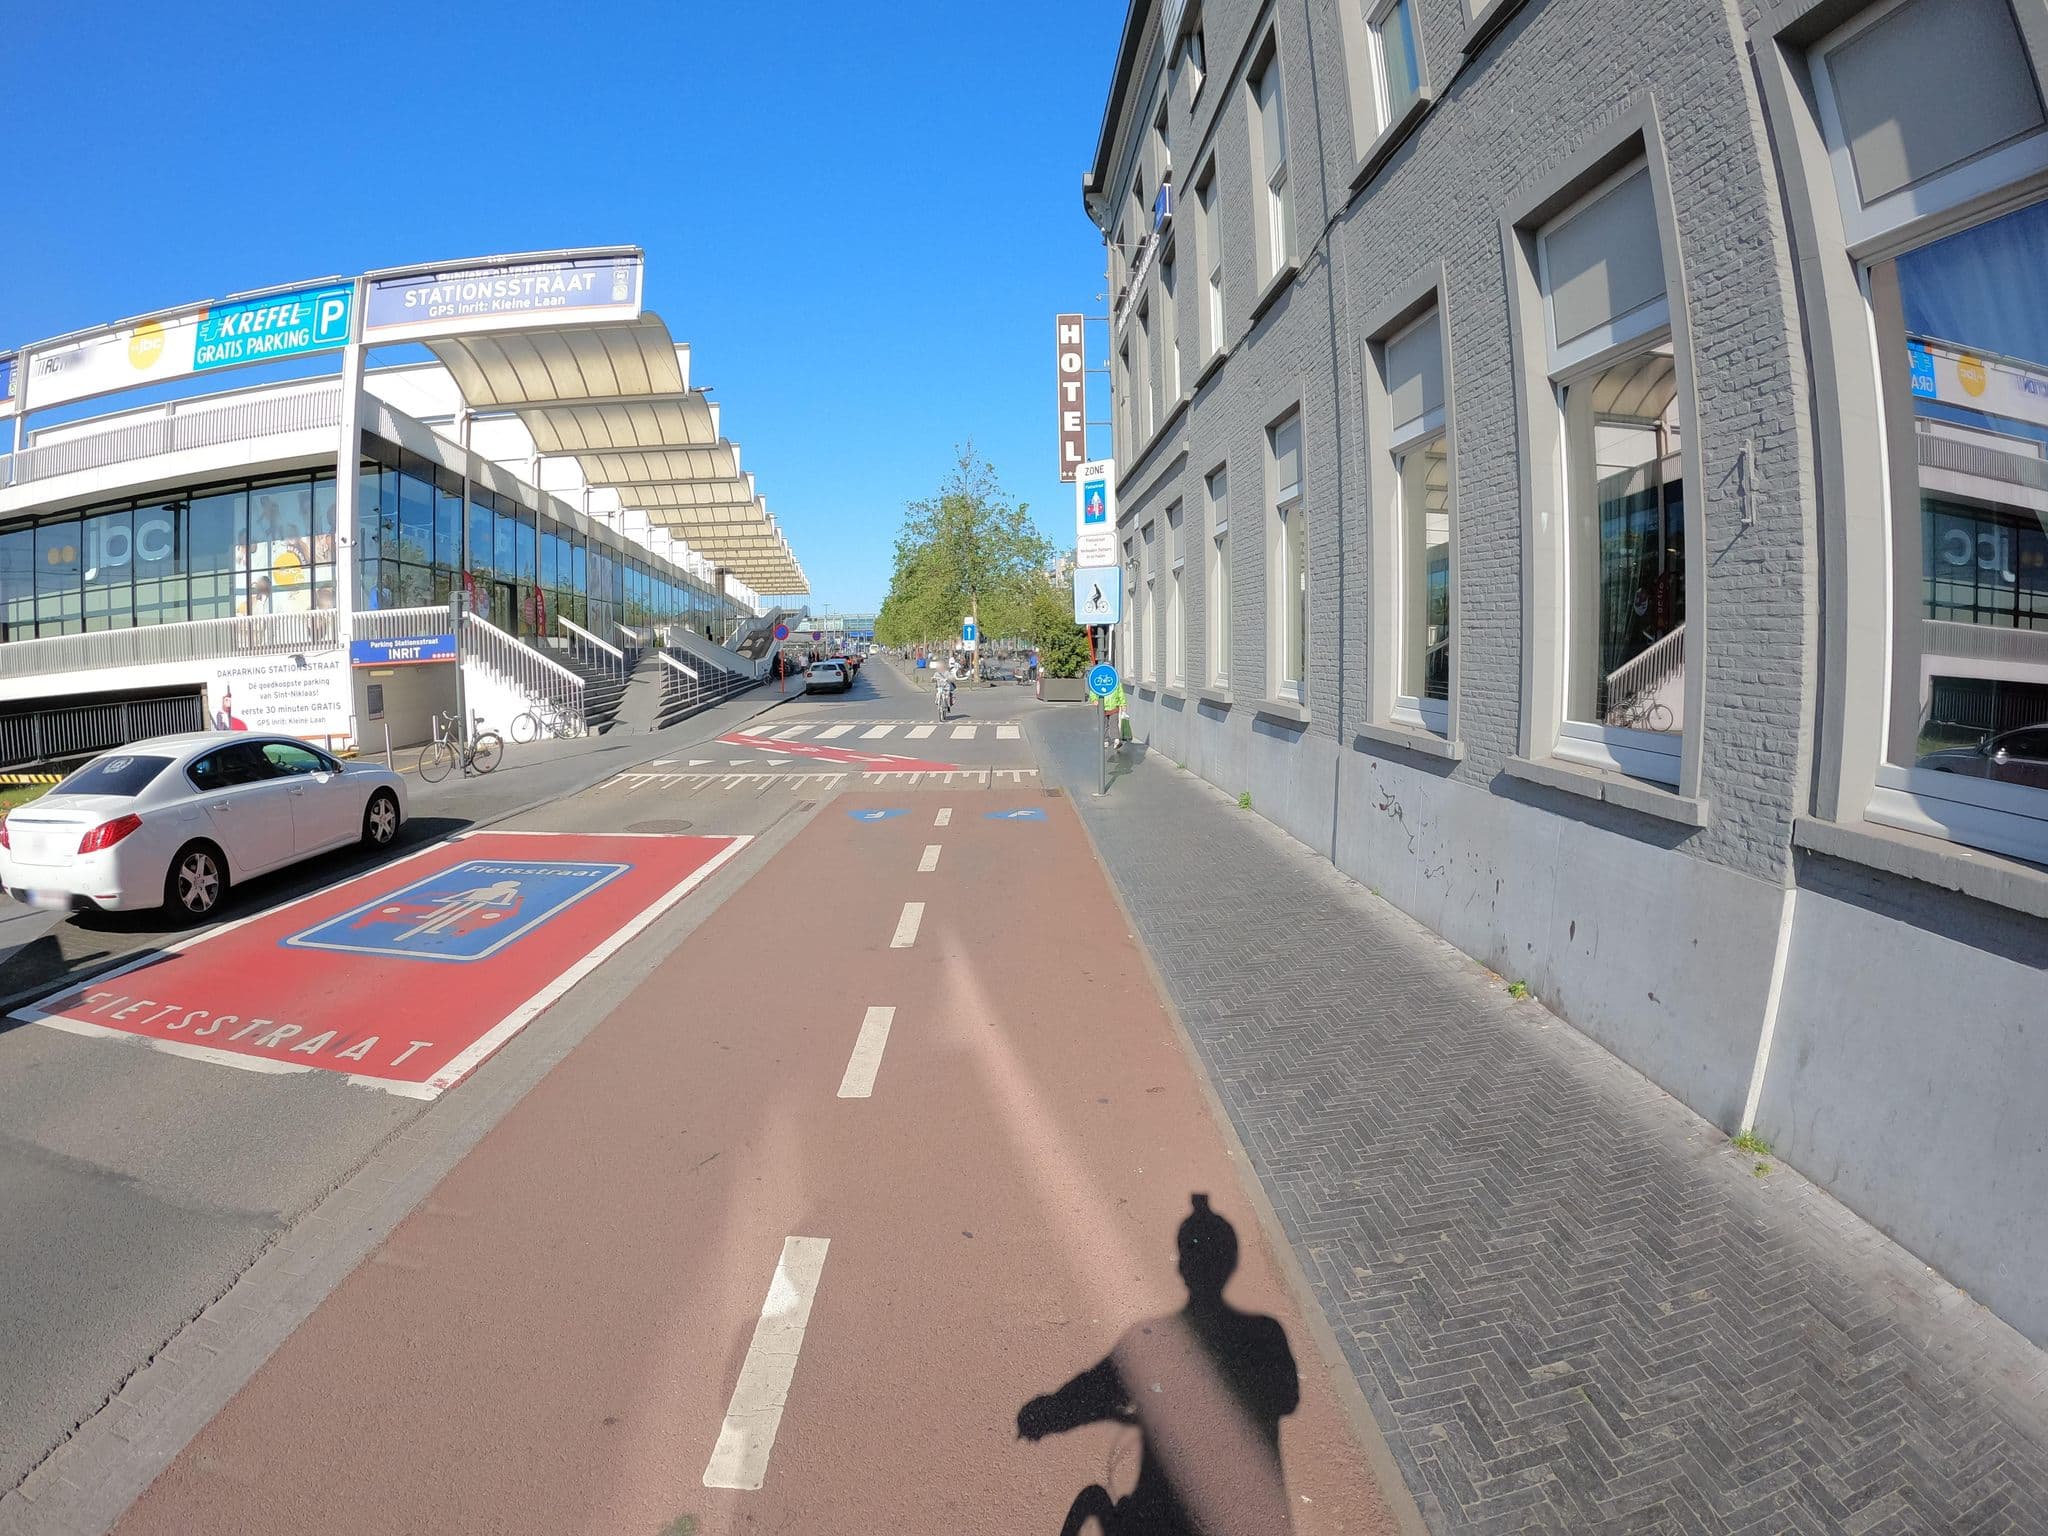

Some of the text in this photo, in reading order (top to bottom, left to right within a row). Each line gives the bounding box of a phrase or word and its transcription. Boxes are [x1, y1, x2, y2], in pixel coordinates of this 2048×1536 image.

[404, 272, 596, 308] STATIONSSTRAAT
[429, 304, 454, 317] GPS
[491, 297, 530, 310] Kleine
[534, 295, 566, 307] Laan
[320, 299, 345, 335] P
[197, 328, 309, 363] GRATIS PARKING
[1060, 324, 1082, 462] HOTEL
[1084, 464, 1105, 476] ZONE
[85, 515, 172, 581] jbc
[370, 638, 438, 649] Parking Stationsstraat
[388, 647, 421, 660] INRIT
[217, 661, 340, 677] DAKPARKING STATIONSSTRAAT
[259, 681, 301, 690] goedkoopste
[303, 678, 330, 687] parking
[273, 690, 319, 699] Sint-Niklaas!
[241, 702, 341, 715] eerste 30 minuten GRATIS
[463, 865, 602, 877] Fietsstraat
[82, 991, 434, 1067] FIETSSTRAAT
